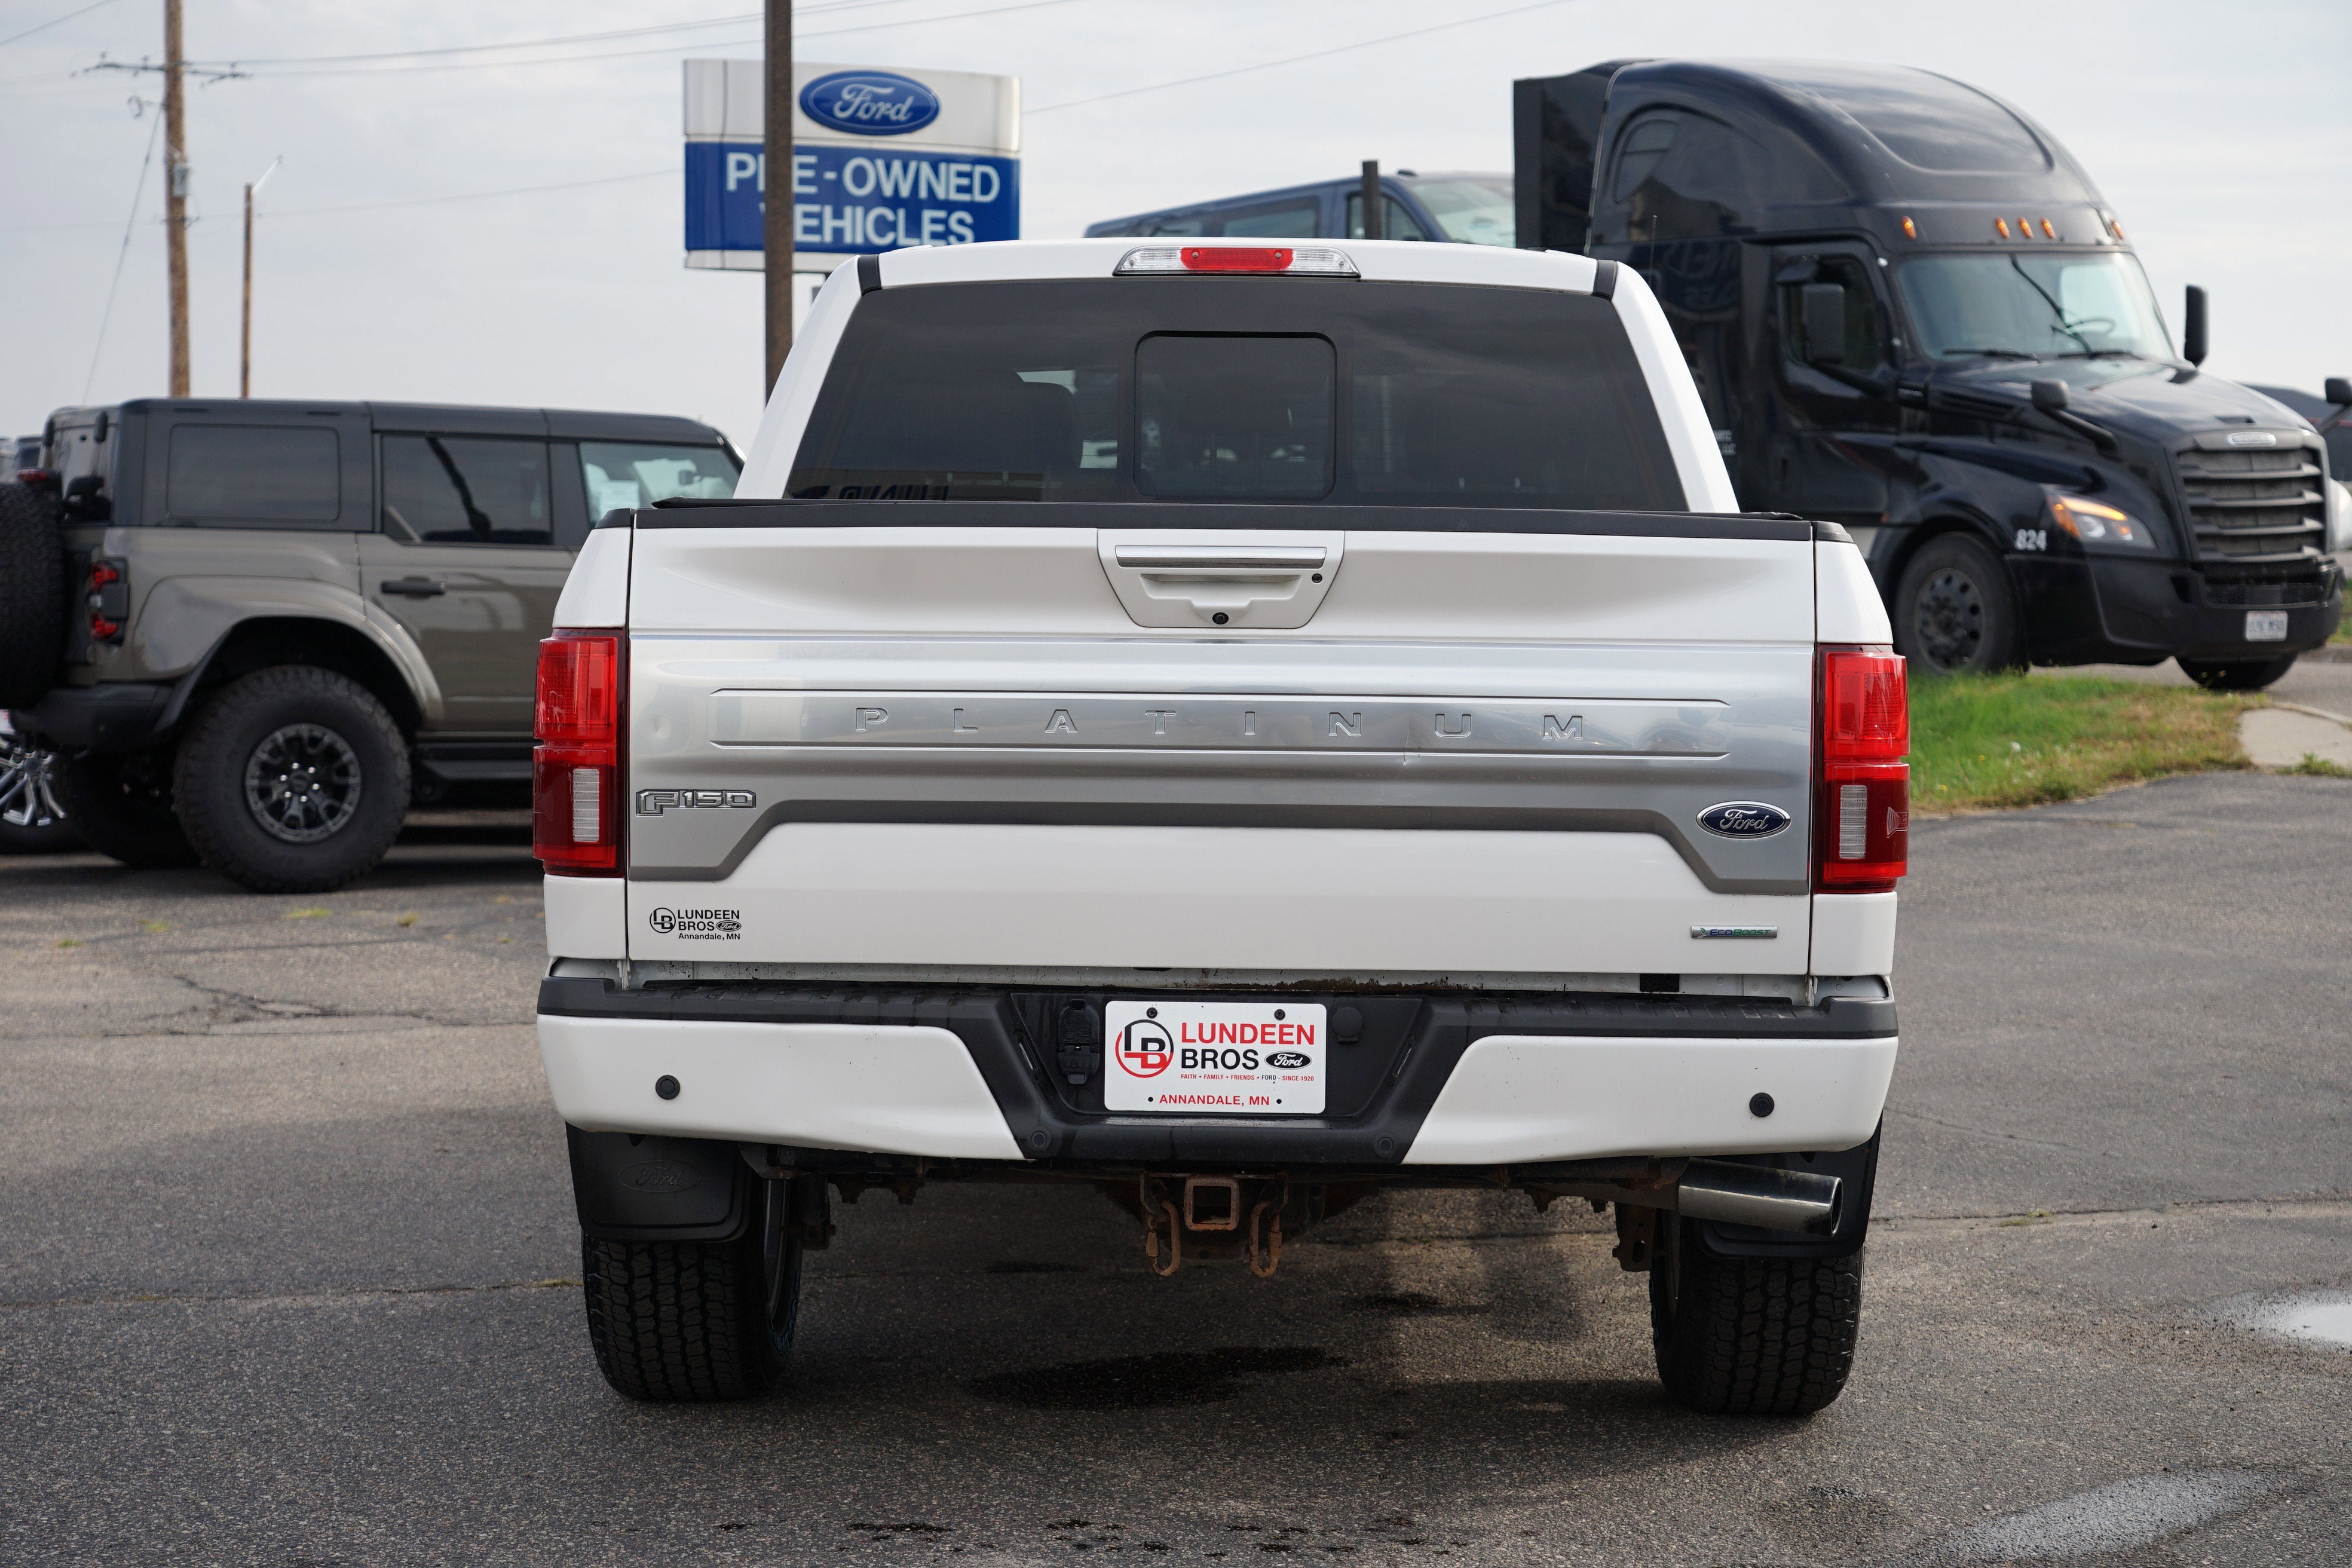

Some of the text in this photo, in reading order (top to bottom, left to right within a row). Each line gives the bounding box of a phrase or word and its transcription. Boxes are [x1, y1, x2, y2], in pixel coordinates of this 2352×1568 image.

[833, 84, 914, 122] Ford
[726, 152, 1001, 203] PE-OWNED
[760, 202, 975, 247] EHICLES
[2015, 529, 2047, 550] 824
[855, 707, 1583, 741] PLATINUM
[1719, 809, 1769, 830] Ford
[678, 909, 740, 920] LUNDEEN
[678, 922, 714, 932] BROS
[678, 933, 724, 941] Annandale,
[1181, 1022, 1314, 1045] LUNDEEN
[1181, 1049, 1303, 1070] BROS Ford
[1159, 1094, 1269, 1106] ANNANDALE, MN
[636, 1166, 684, 1187] Ford
